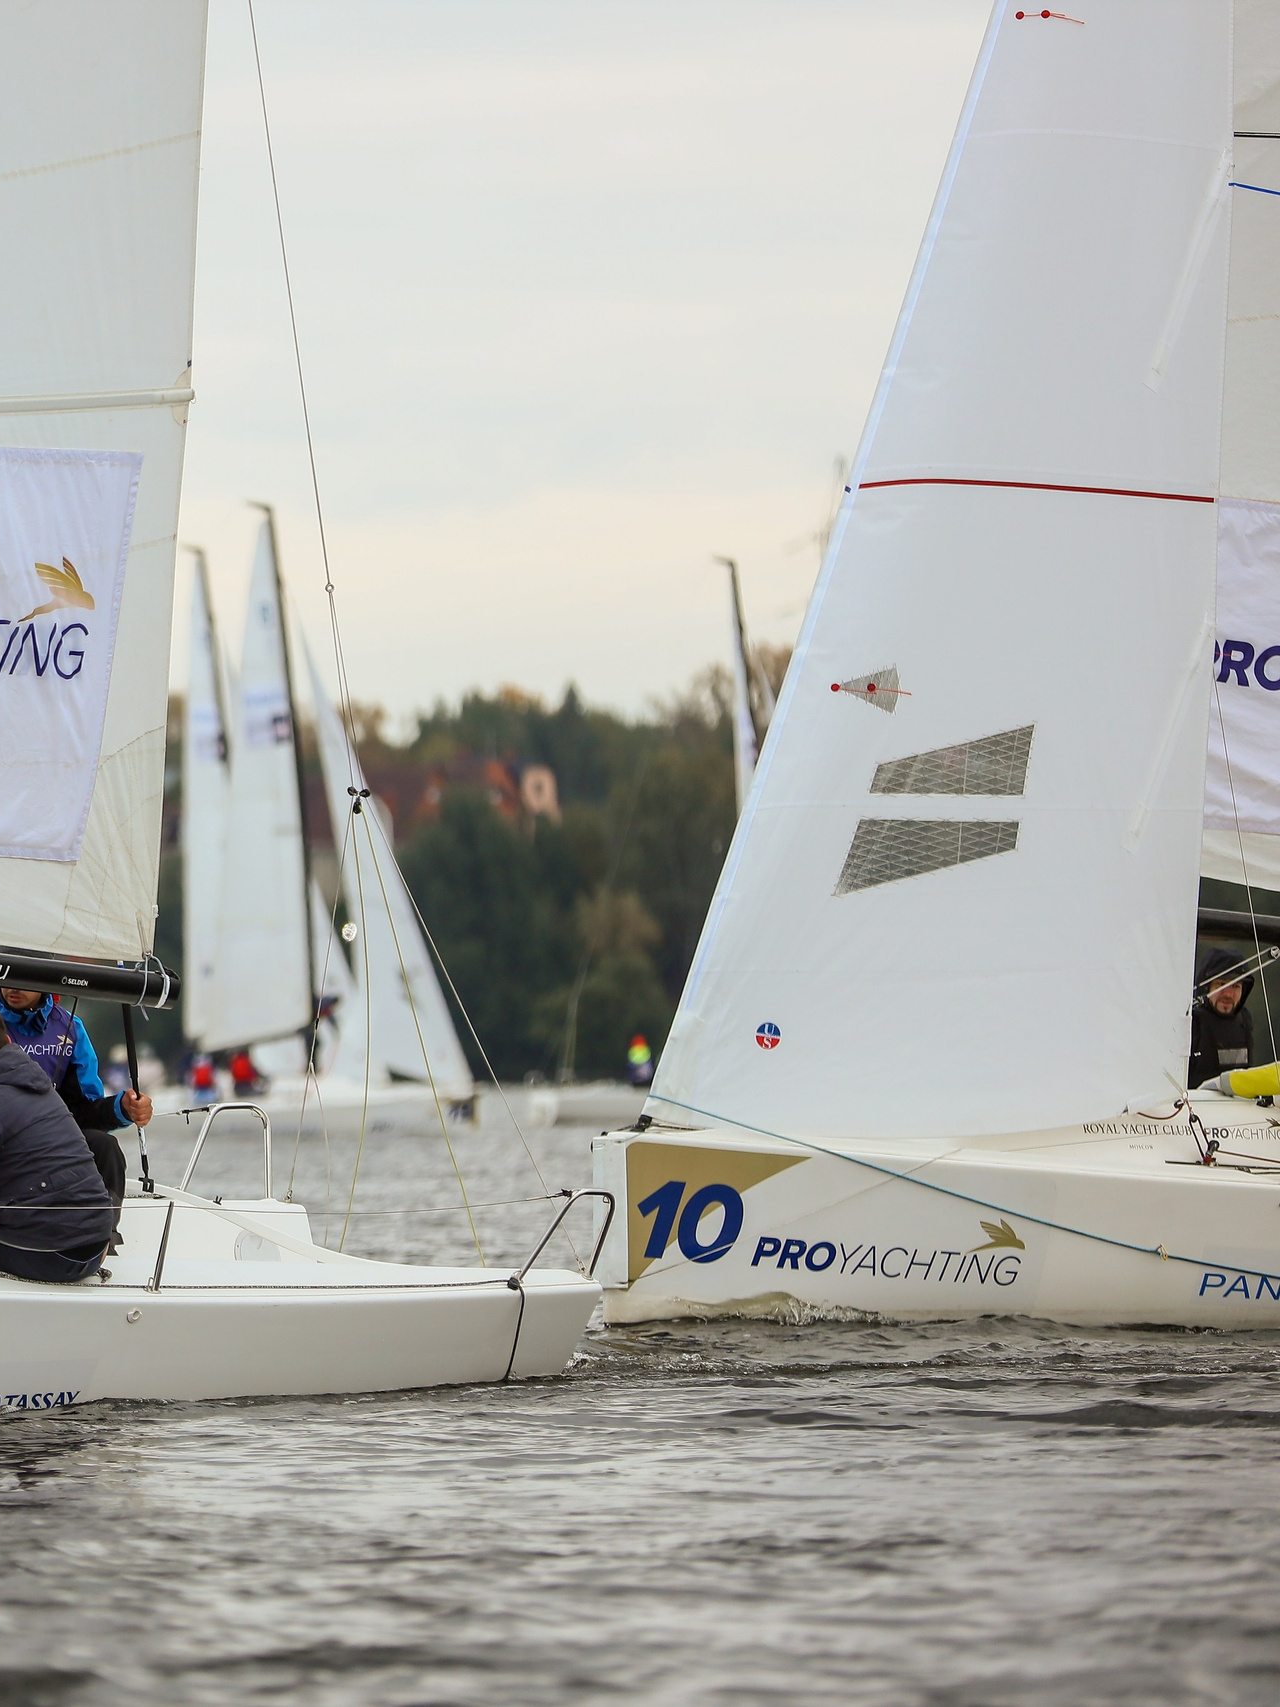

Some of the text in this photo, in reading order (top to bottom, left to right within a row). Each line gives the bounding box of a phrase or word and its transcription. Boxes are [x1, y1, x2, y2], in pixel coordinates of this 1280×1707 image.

[19, 1043, 73, 1057] YACHTING
[1082, 1123, 1192, 1136] ROYAL YACHT CLUB
[637, 1180, 744, 1264] 10
[750, 1236, 1022, 1287] PROYACHTING
[1198, 1272, 1280, 1300] PAN
[3, 1390, 81, 1409] TASSAY
